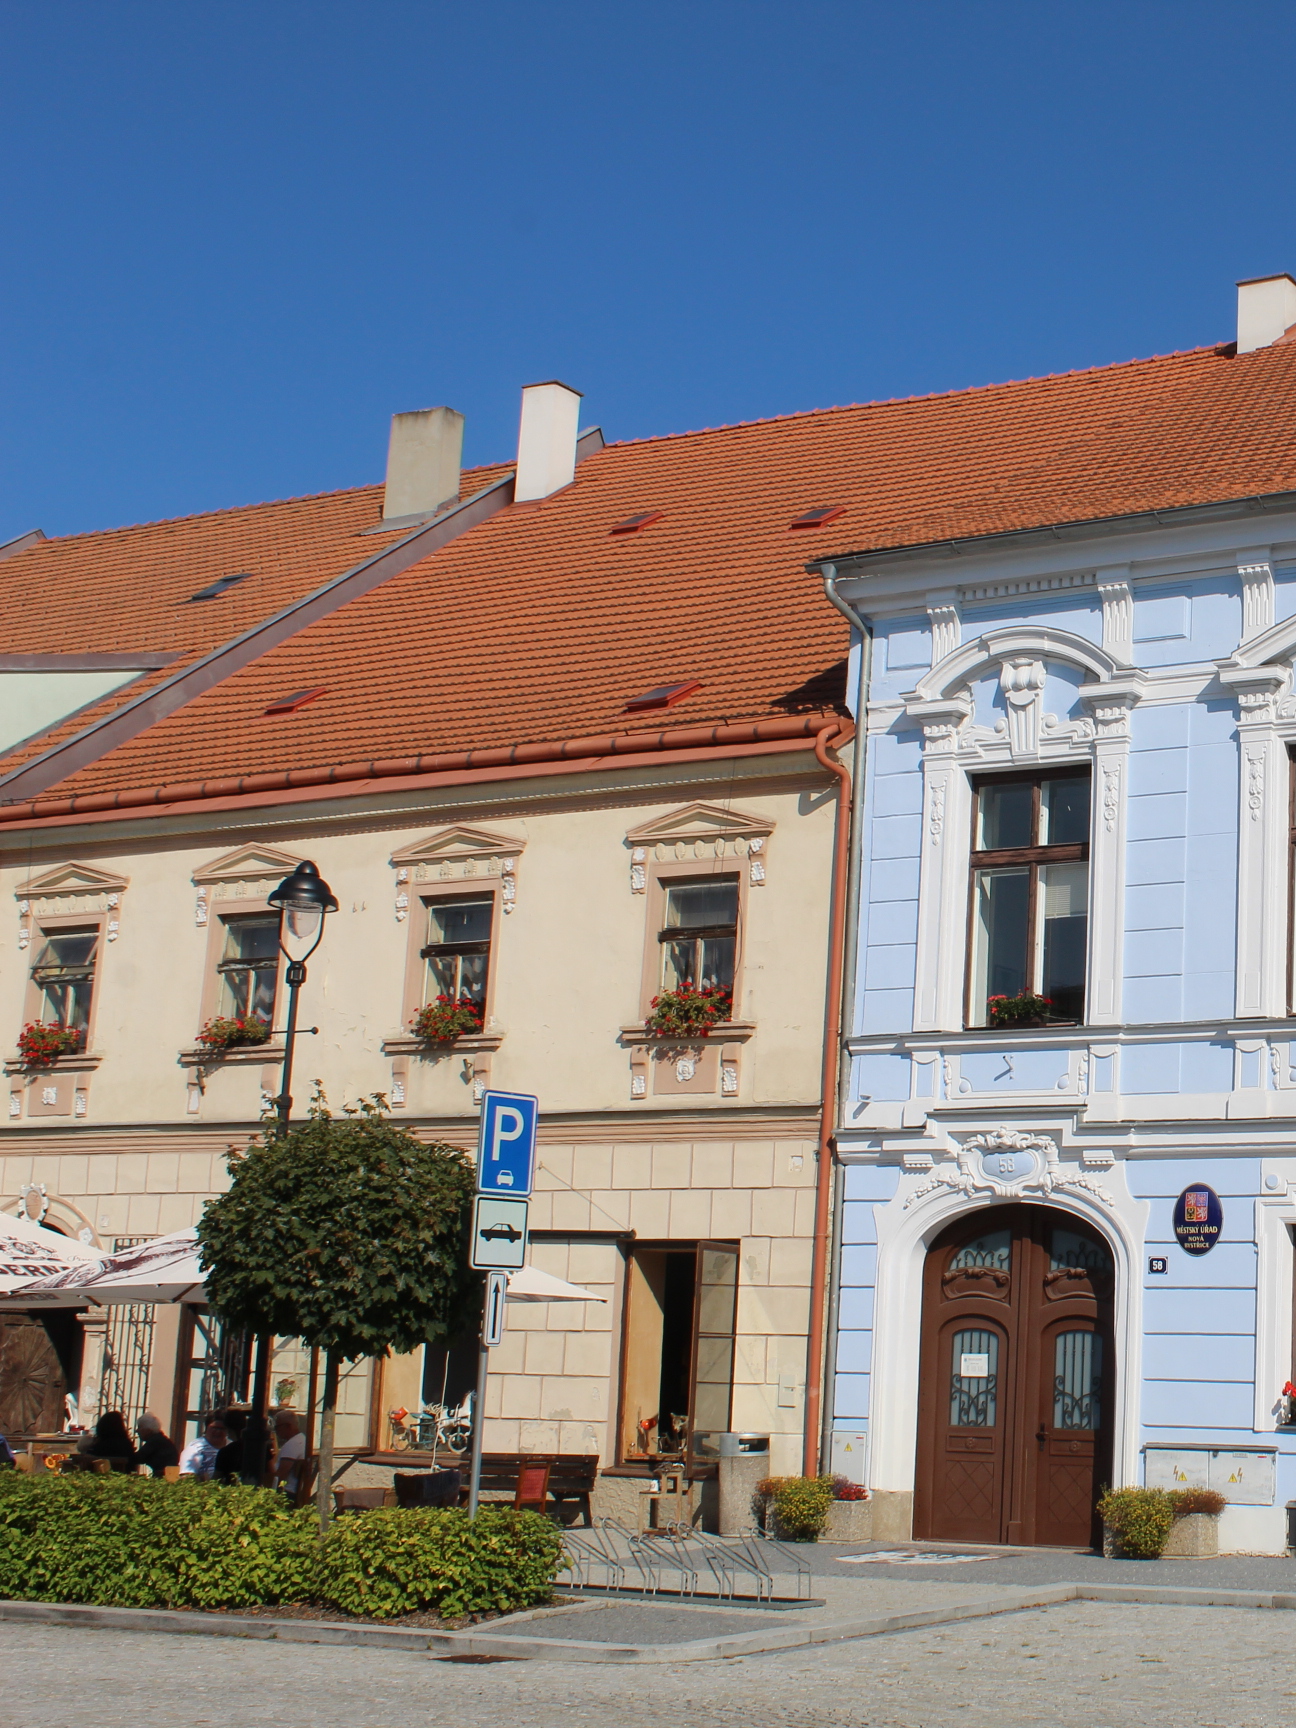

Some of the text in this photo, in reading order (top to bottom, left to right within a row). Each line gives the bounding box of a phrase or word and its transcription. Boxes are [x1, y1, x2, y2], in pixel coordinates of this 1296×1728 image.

[492, 1105, 525, 1161] P
[999, 1157, 1015, 1173] 58
[1176, 1224, 1218, 1234] MĚSTSKÝ ÚŘAD
[1152, 1260, 1163, 1271] 58
